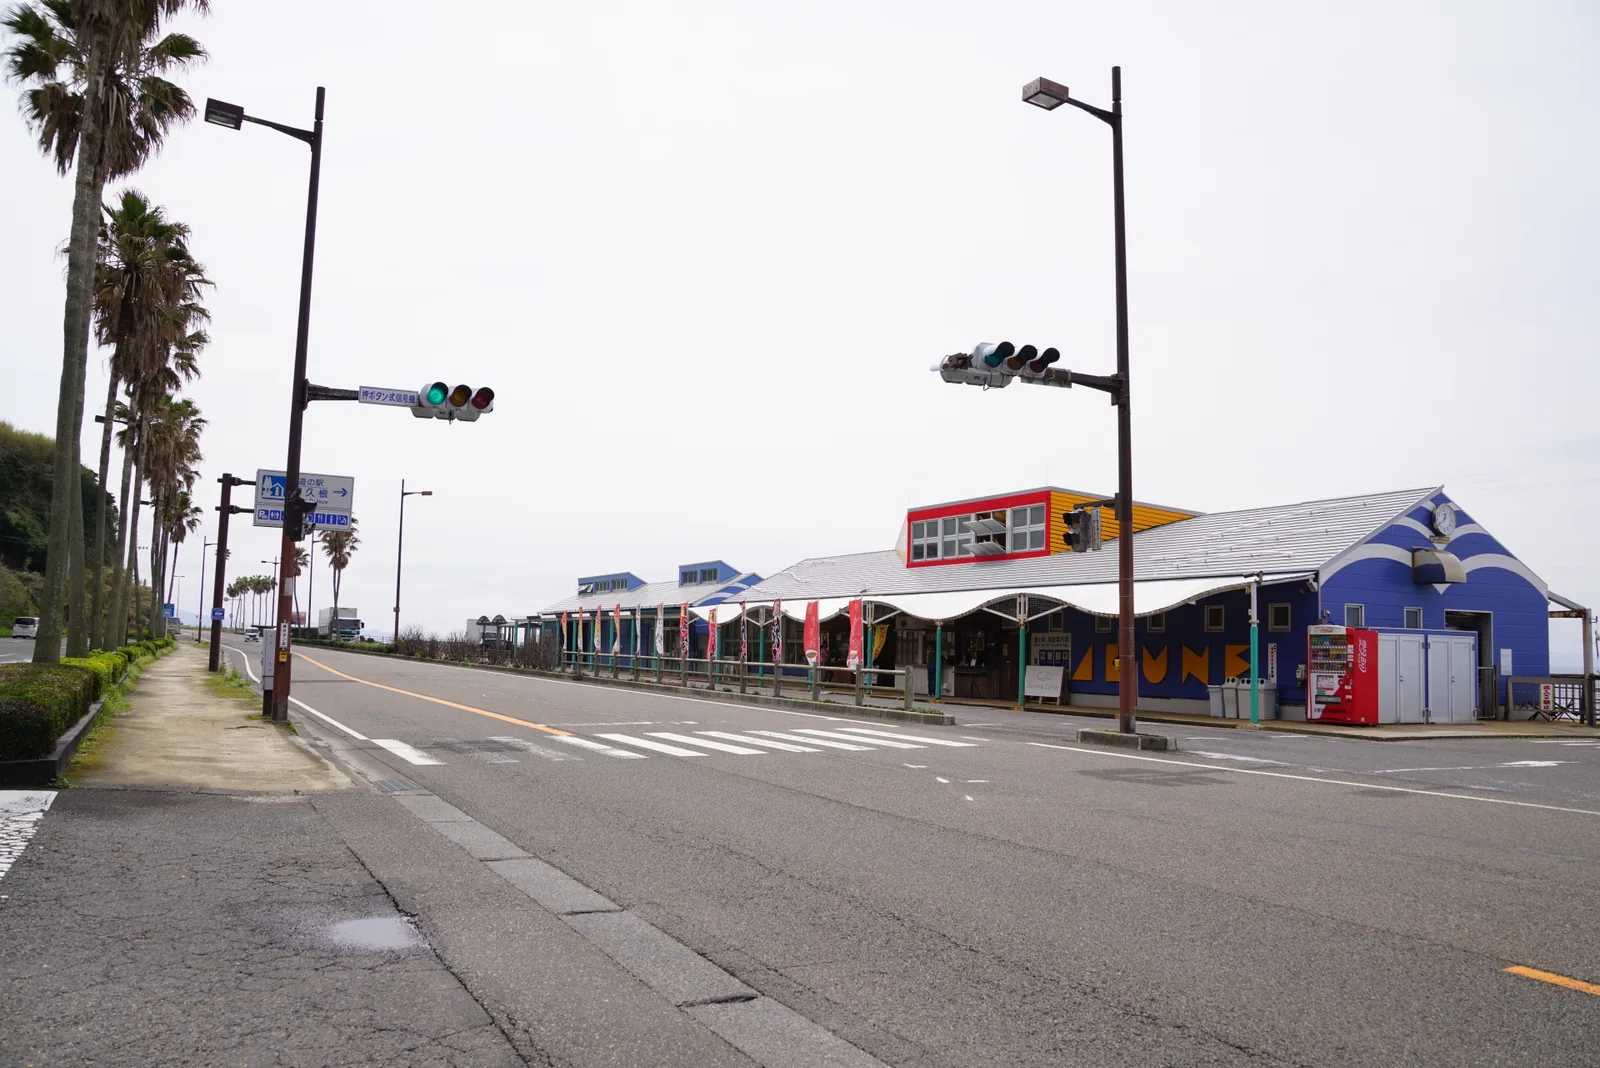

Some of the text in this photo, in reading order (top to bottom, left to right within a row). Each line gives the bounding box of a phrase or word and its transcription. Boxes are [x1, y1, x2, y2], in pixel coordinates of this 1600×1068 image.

[361, 390, 416, 404] 押ボタン式信号機
[298, 477, 324, 487] 道の駅
